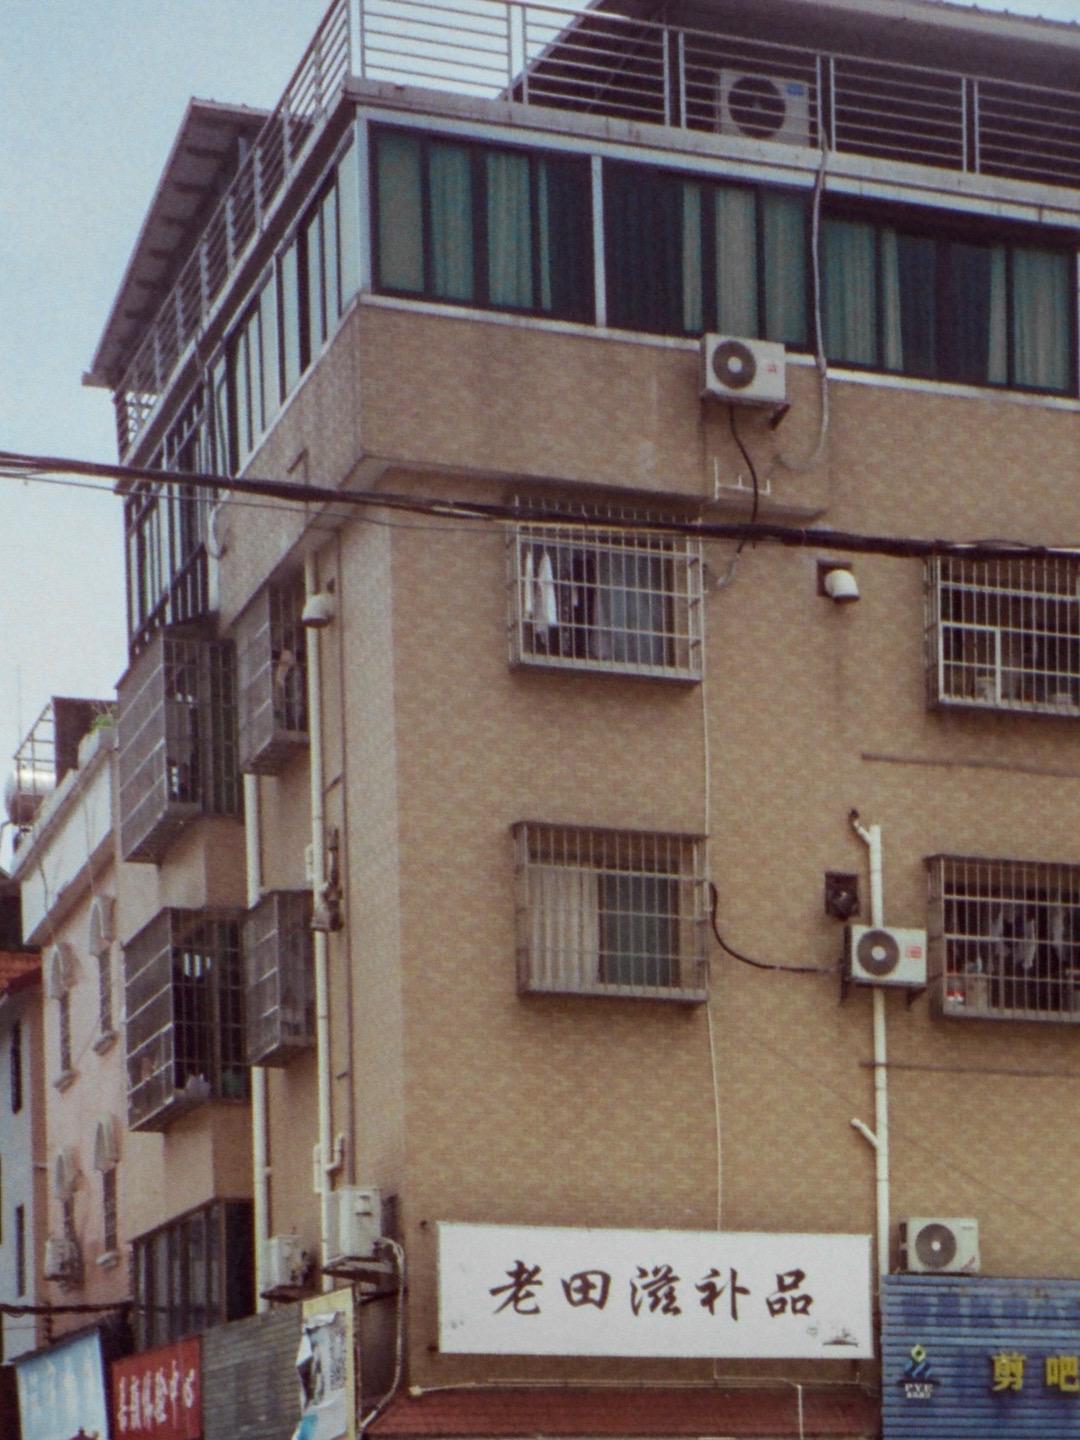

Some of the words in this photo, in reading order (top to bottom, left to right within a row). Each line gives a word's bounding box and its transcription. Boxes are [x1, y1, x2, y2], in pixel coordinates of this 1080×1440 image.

[488, 1259, 815, 1322] 老田滋补品
